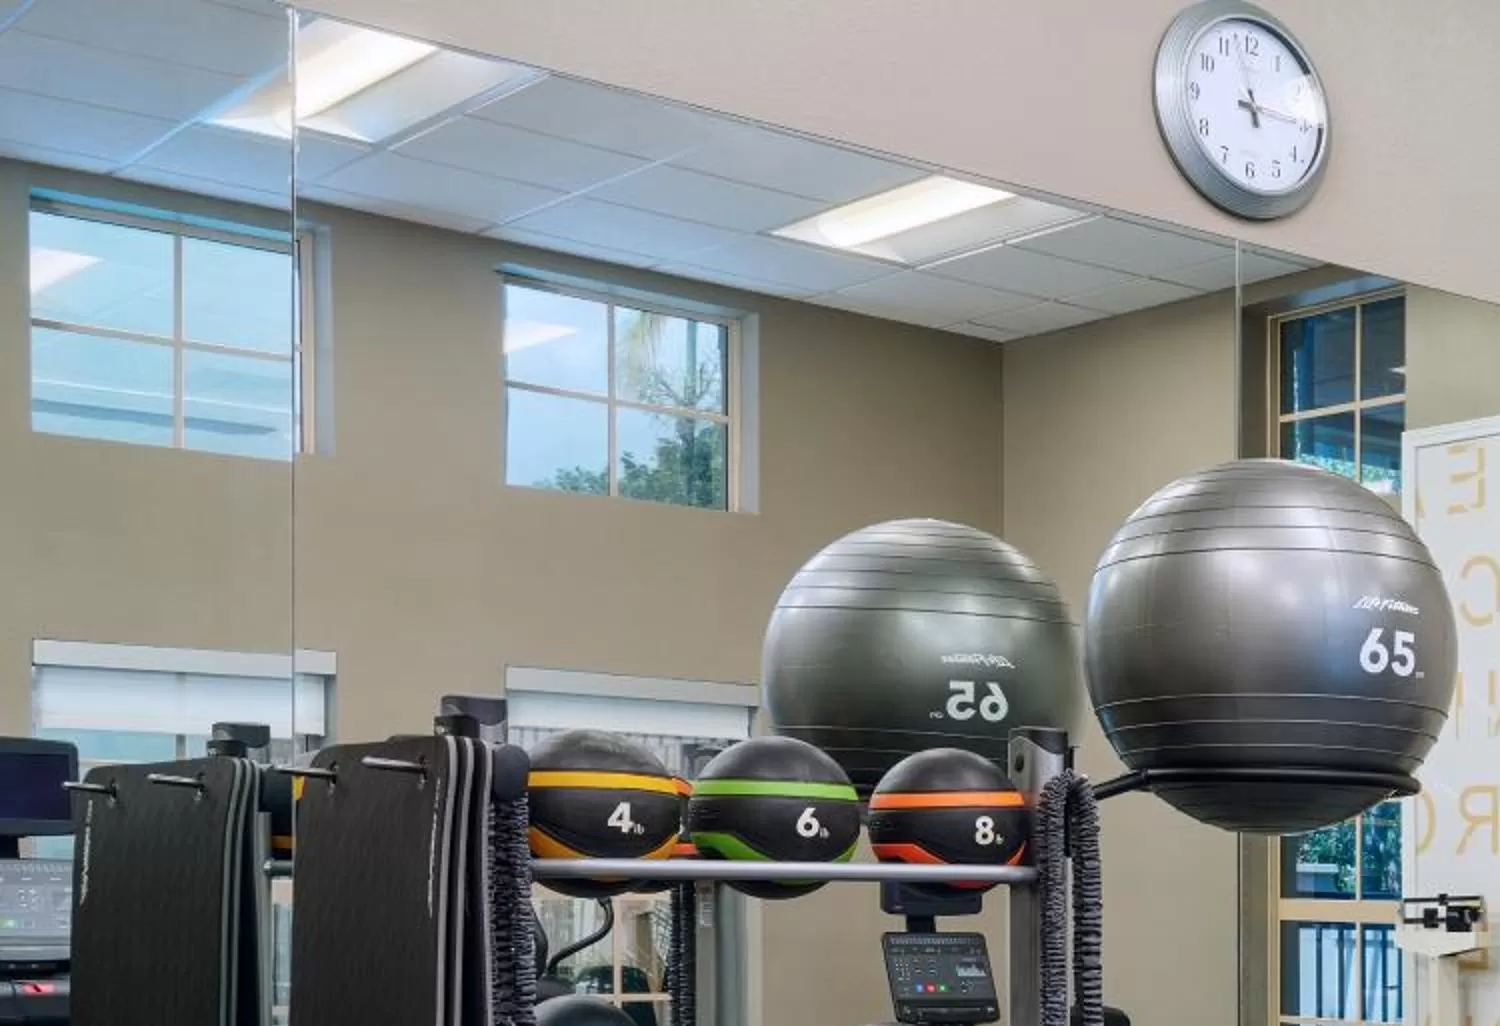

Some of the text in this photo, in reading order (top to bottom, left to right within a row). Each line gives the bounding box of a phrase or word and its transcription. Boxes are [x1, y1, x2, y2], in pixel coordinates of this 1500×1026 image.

[1219, 36, 1229, 57] 11
[1245, 34, 1259, 57] 12
[1200, 52, 1215, 72] 10
[1189, 81, 1200, 100] 9
[1199, 118, 1209, 136] 8
[1220, 144, 1229, 163] 7
[1245, 161, 1255, 179] 6
[1271, 159, 1281, 179] 5
[1360, 628, 1415, 677] 65
